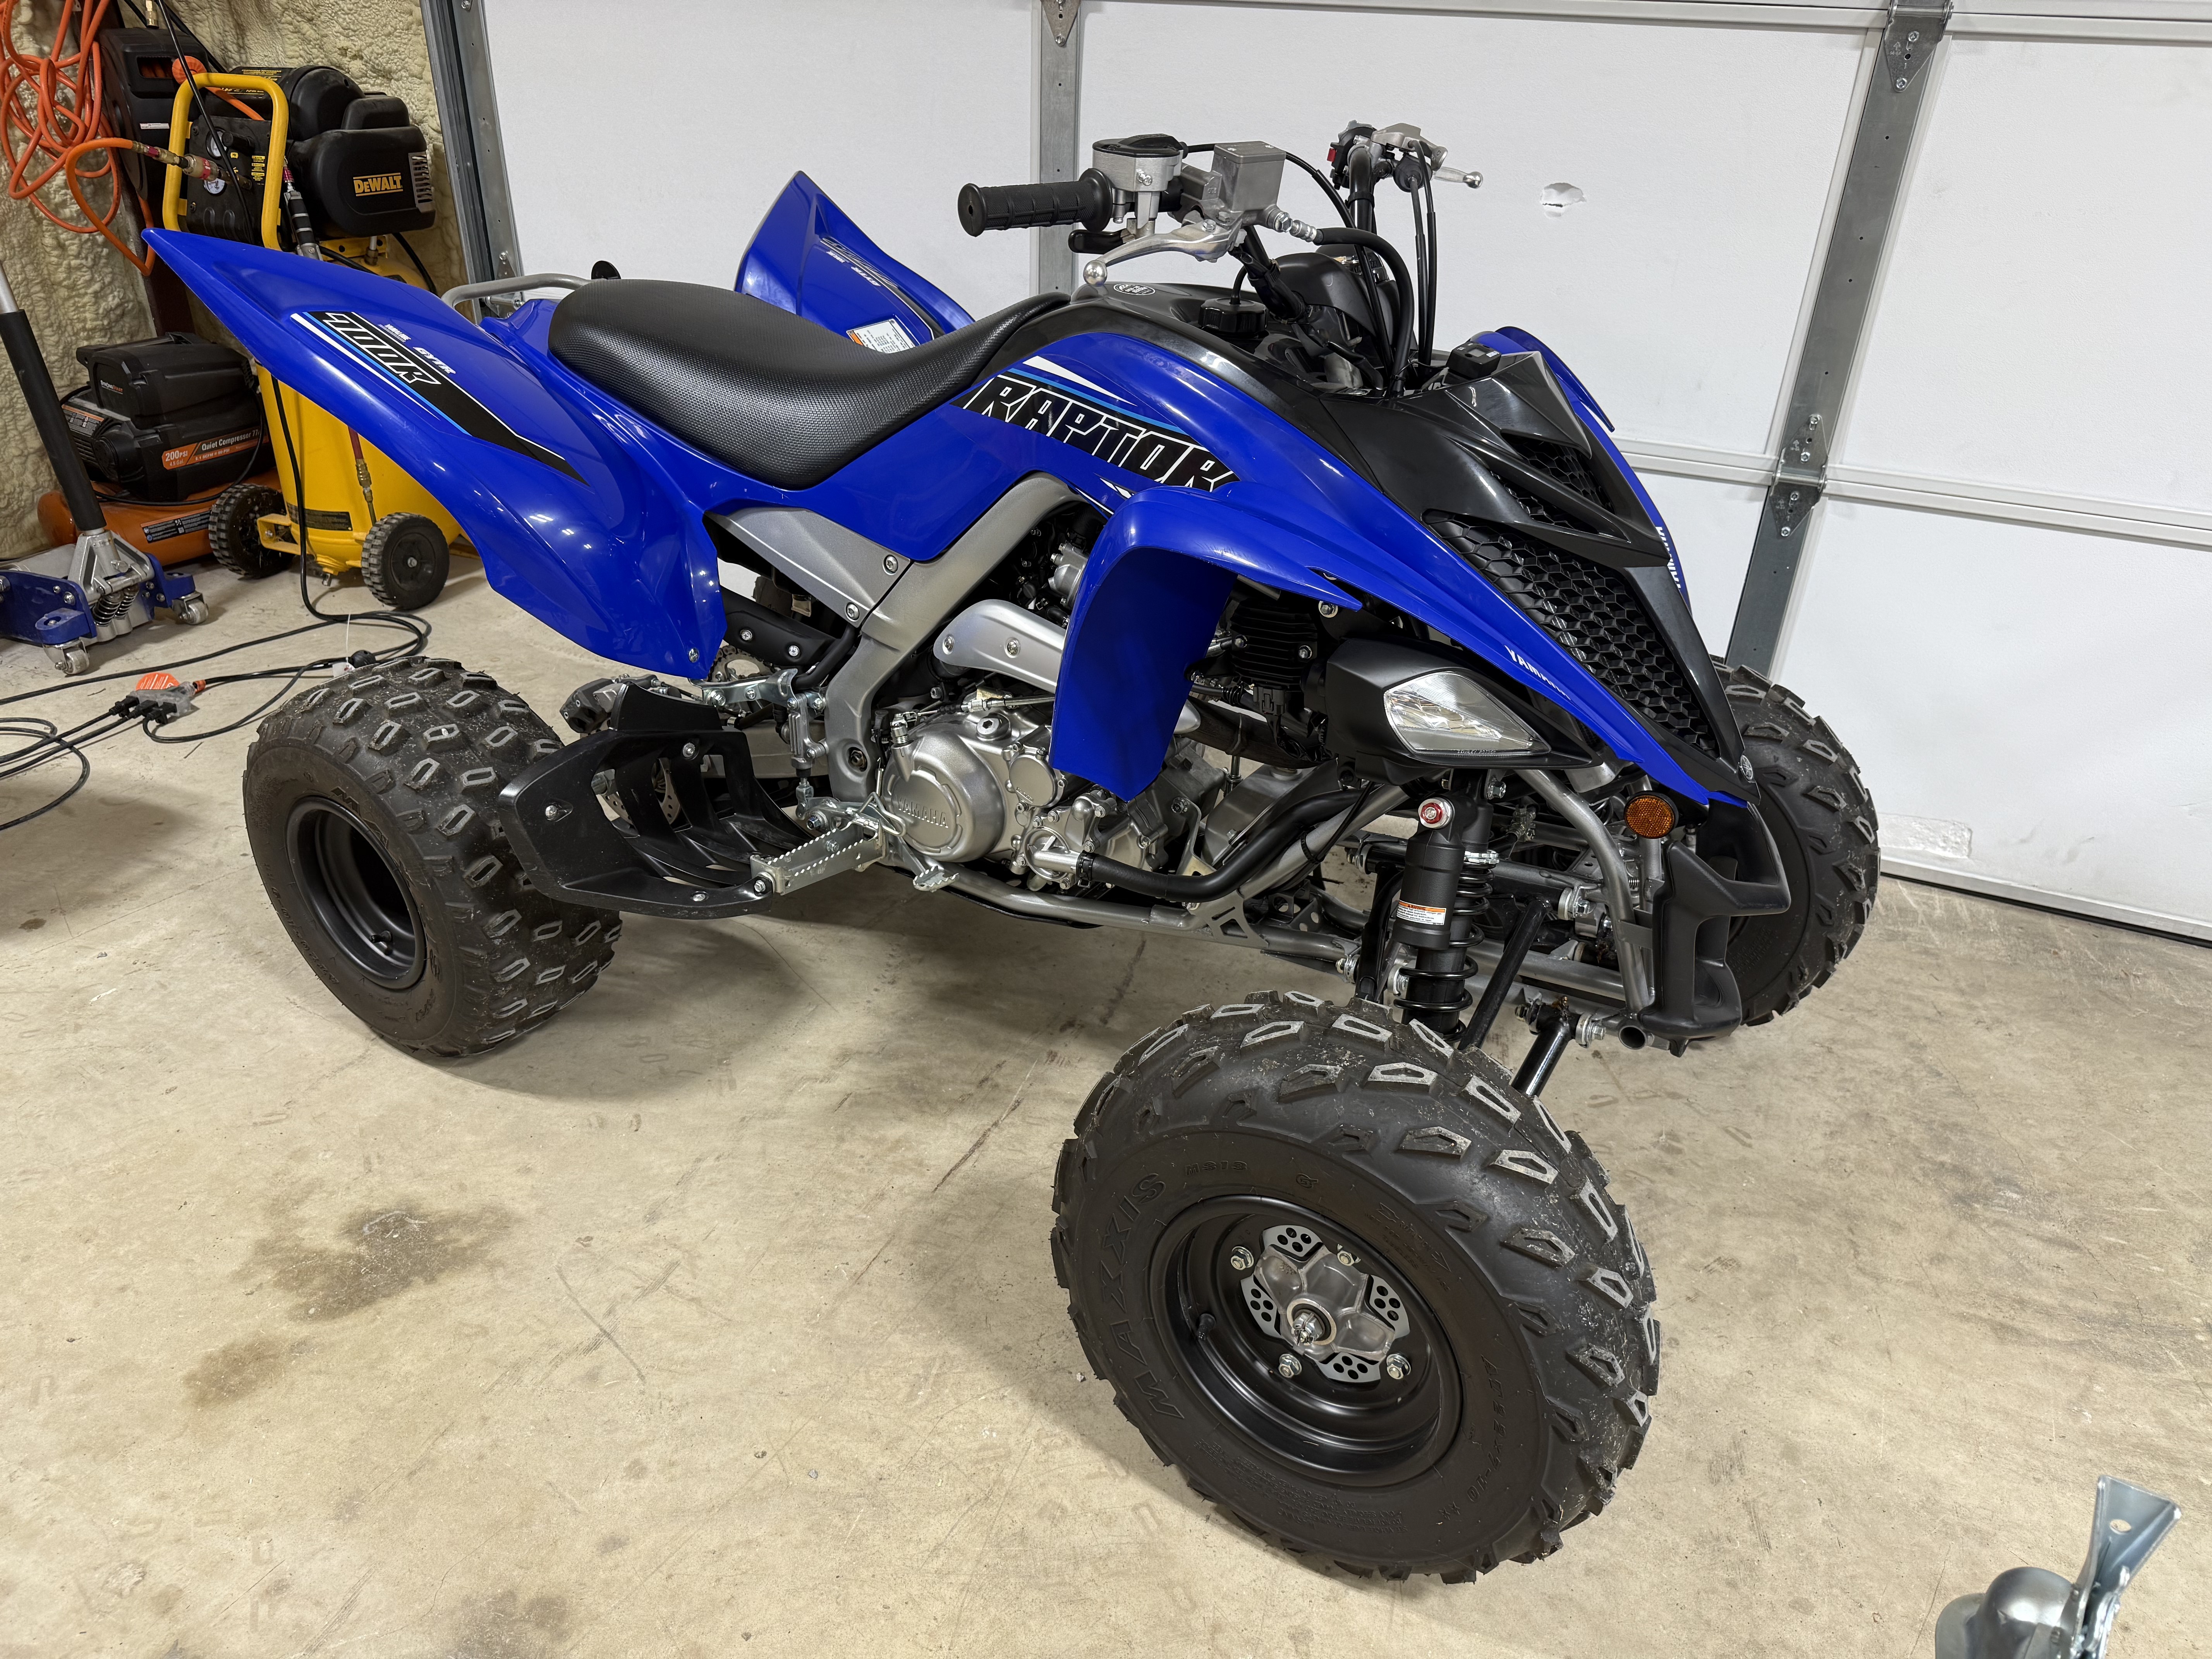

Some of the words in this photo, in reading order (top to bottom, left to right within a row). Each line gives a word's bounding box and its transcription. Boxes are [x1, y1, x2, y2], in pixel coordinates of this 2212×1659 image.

[323, 312, 441, 385] 700R
[412, 347, 456, 374] GYTR
[202, 442, 217, 451] Quiet
[219, 431, 251, 447] Compressor
[963, 375, 1237, 493] RAPTOR
[896, 795, 949, 828] YAMAHA
[1185, 1161, 1248, 1175] MS13
[1100, 1173, 1184, 1418] MAXXIS
